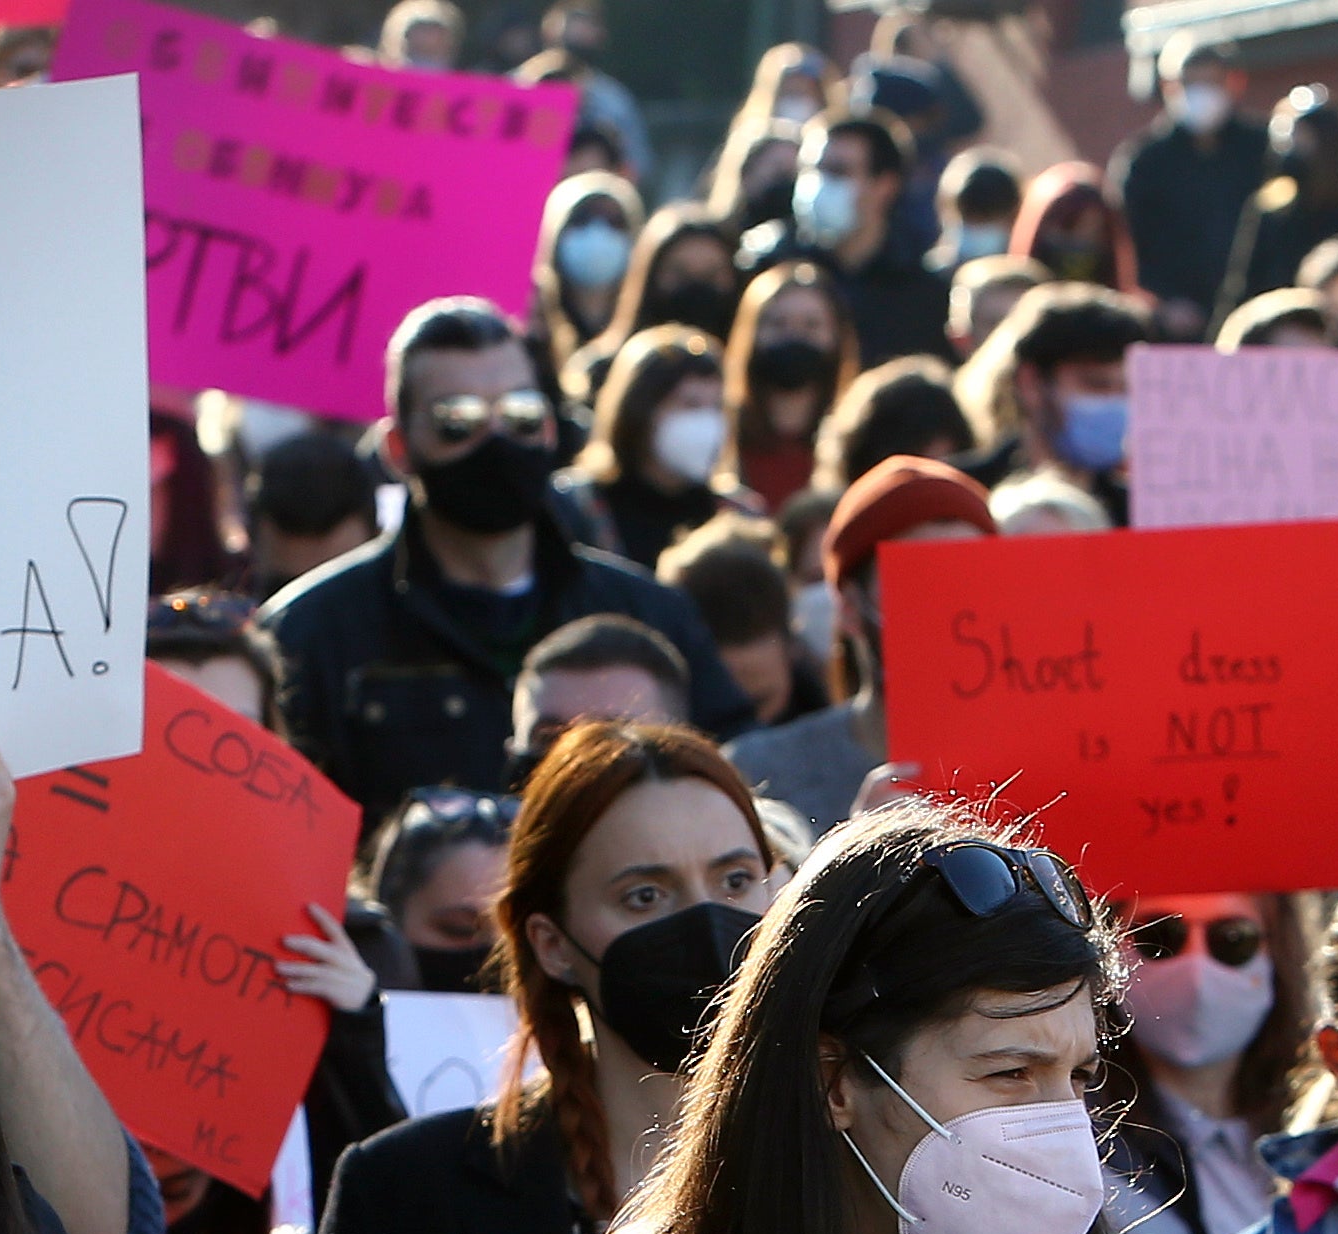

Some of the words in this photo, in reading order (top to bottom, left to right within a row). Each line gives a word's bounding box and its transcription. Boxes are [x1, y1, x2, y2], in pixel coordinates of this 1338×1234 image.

[950, 611, 1107, 699] Short
[1177, 629, 1284, 685] dress
[1078, 731, 1111, 762] is
[1166, 703, 1272, 756] NOT
[164, 709, 322, 830] СОБА
[1139, 773, 1240, 836] yes!
[941, 1181, 972, 1202] N95
